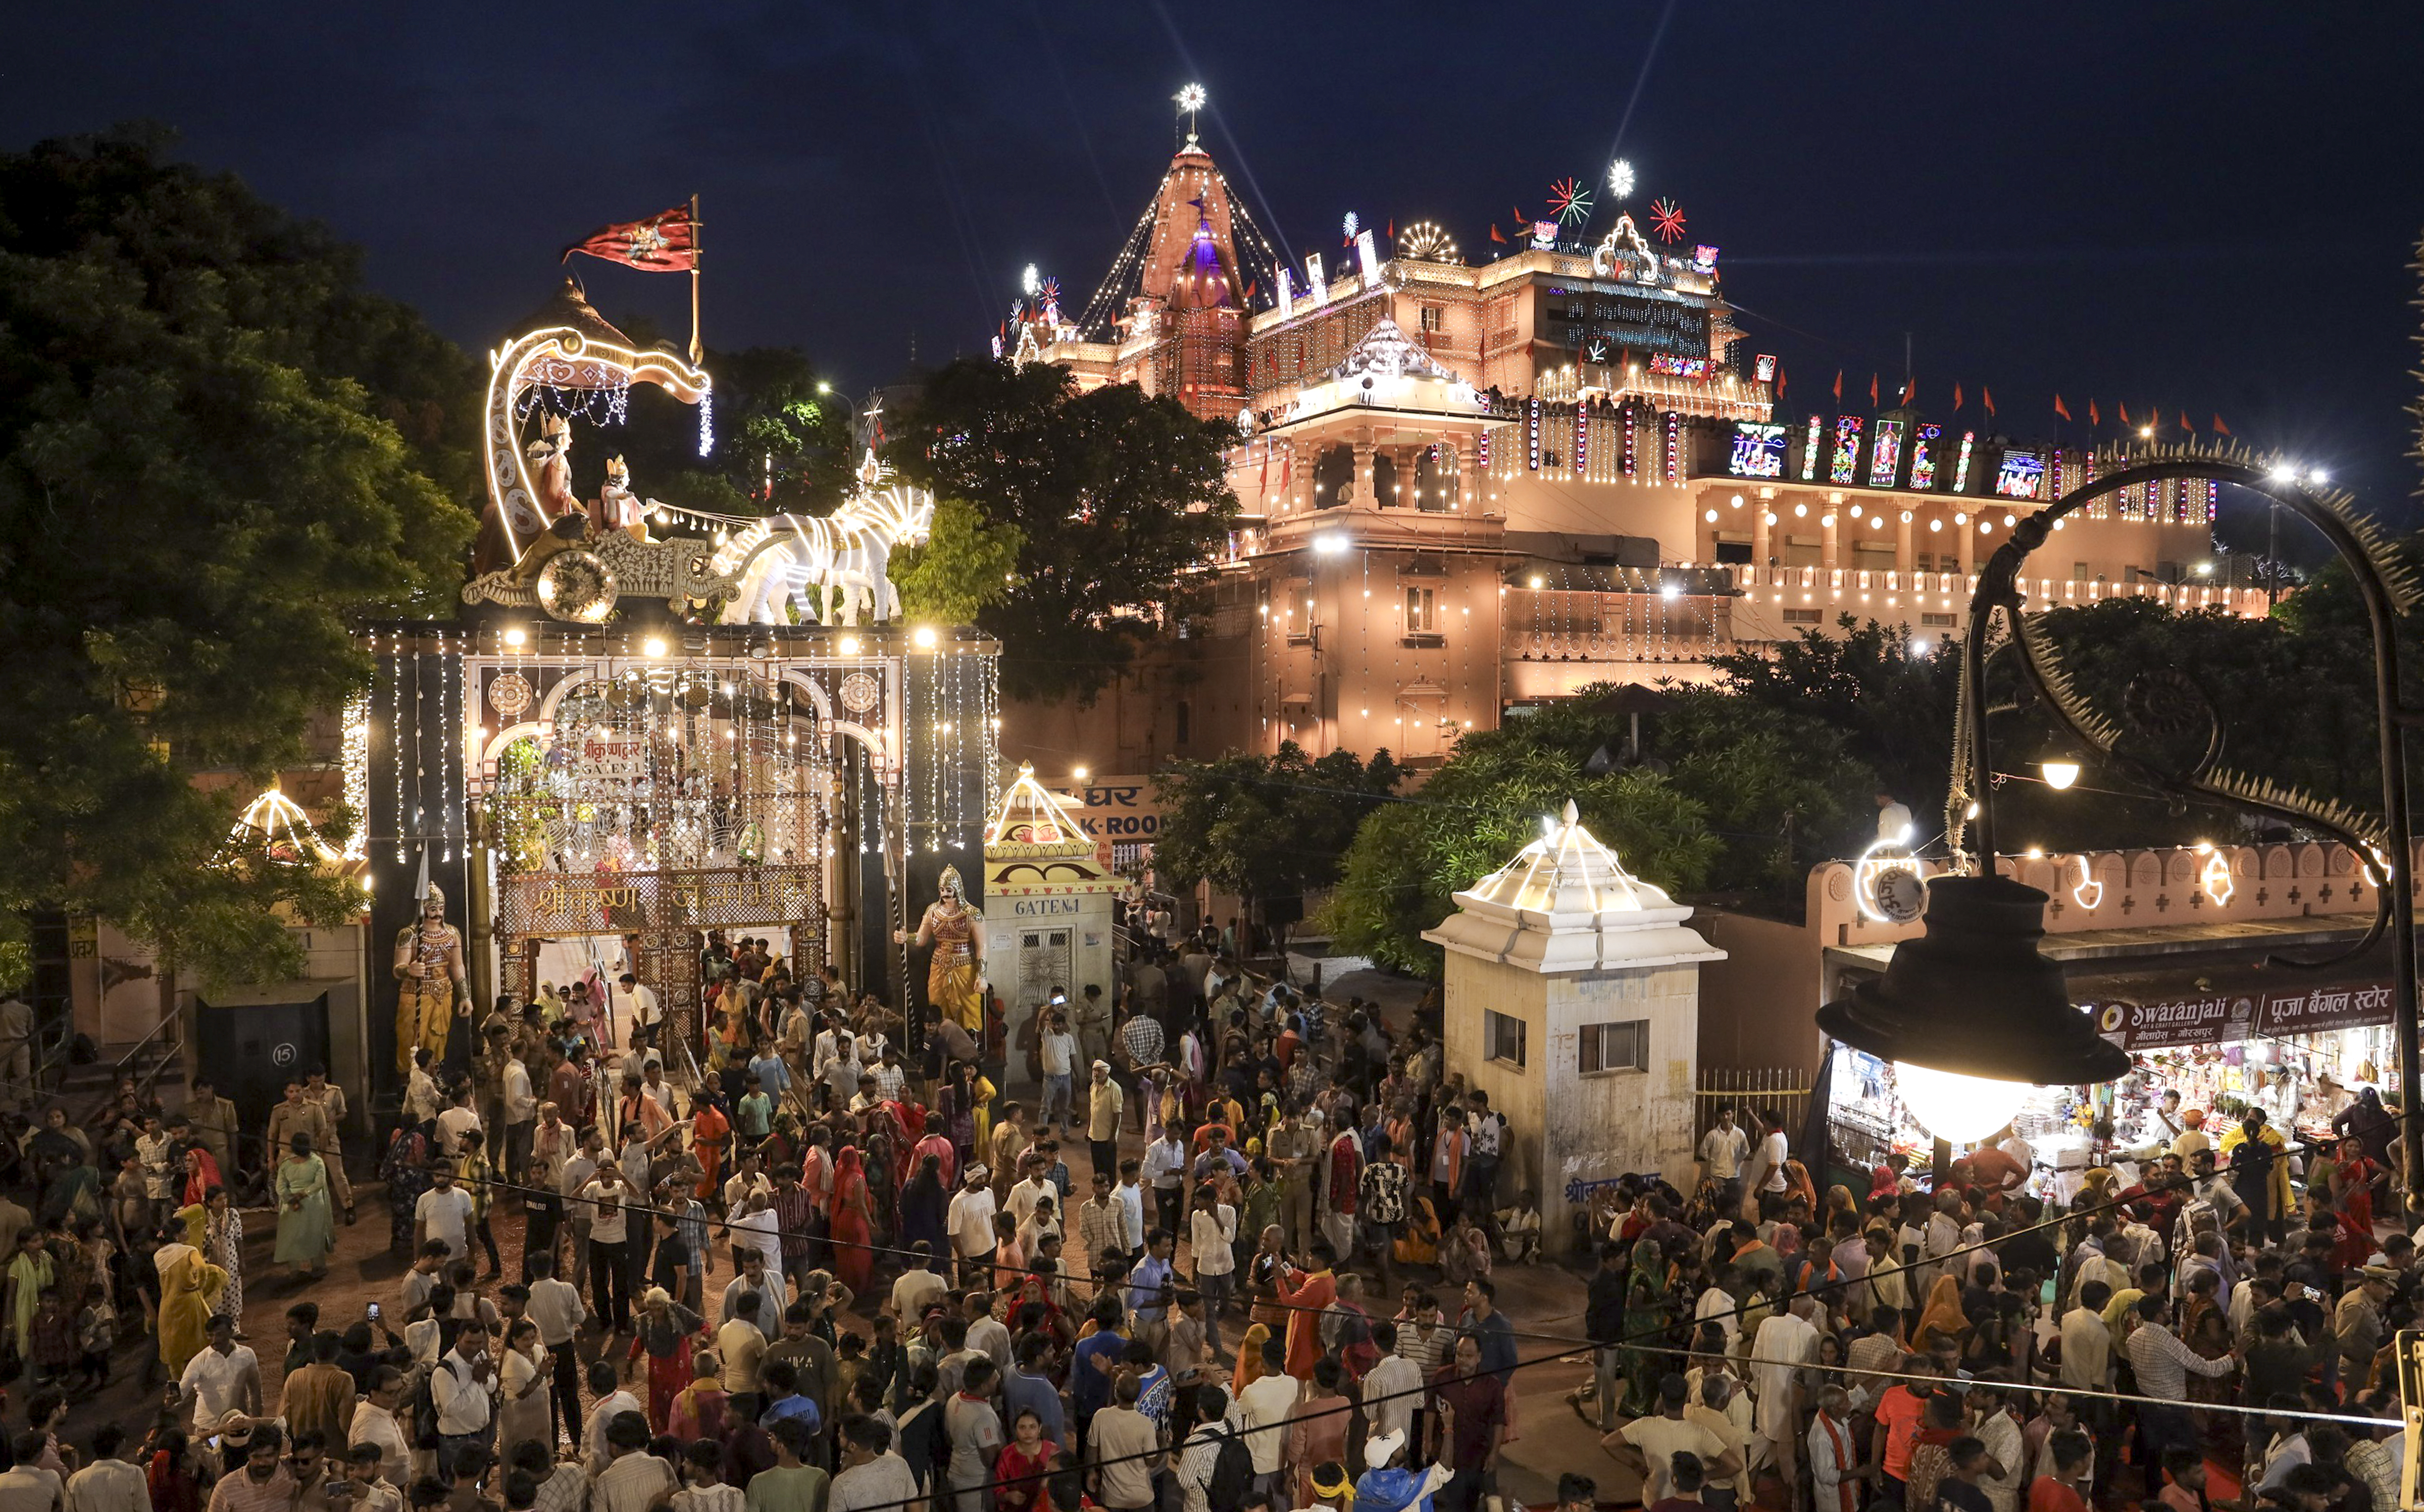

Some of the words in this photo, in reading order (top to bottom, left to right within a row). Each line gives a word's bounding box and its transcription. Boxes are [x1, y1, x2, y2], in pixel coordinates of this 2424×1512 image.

[1015, 900, 1059, 915] GATE
[2271, 997, 2305, 1023] पूजा
[2308, 989, 2351, 1013] बैंगल
[2354, 985, 2392, 1010] स्टोर
[2136, 1030, 2169, 1041] गीताप्रेस
[2178, 1027, 2214, 1038] गोरखपुर
[277, 1048, 290, 1061] 15
